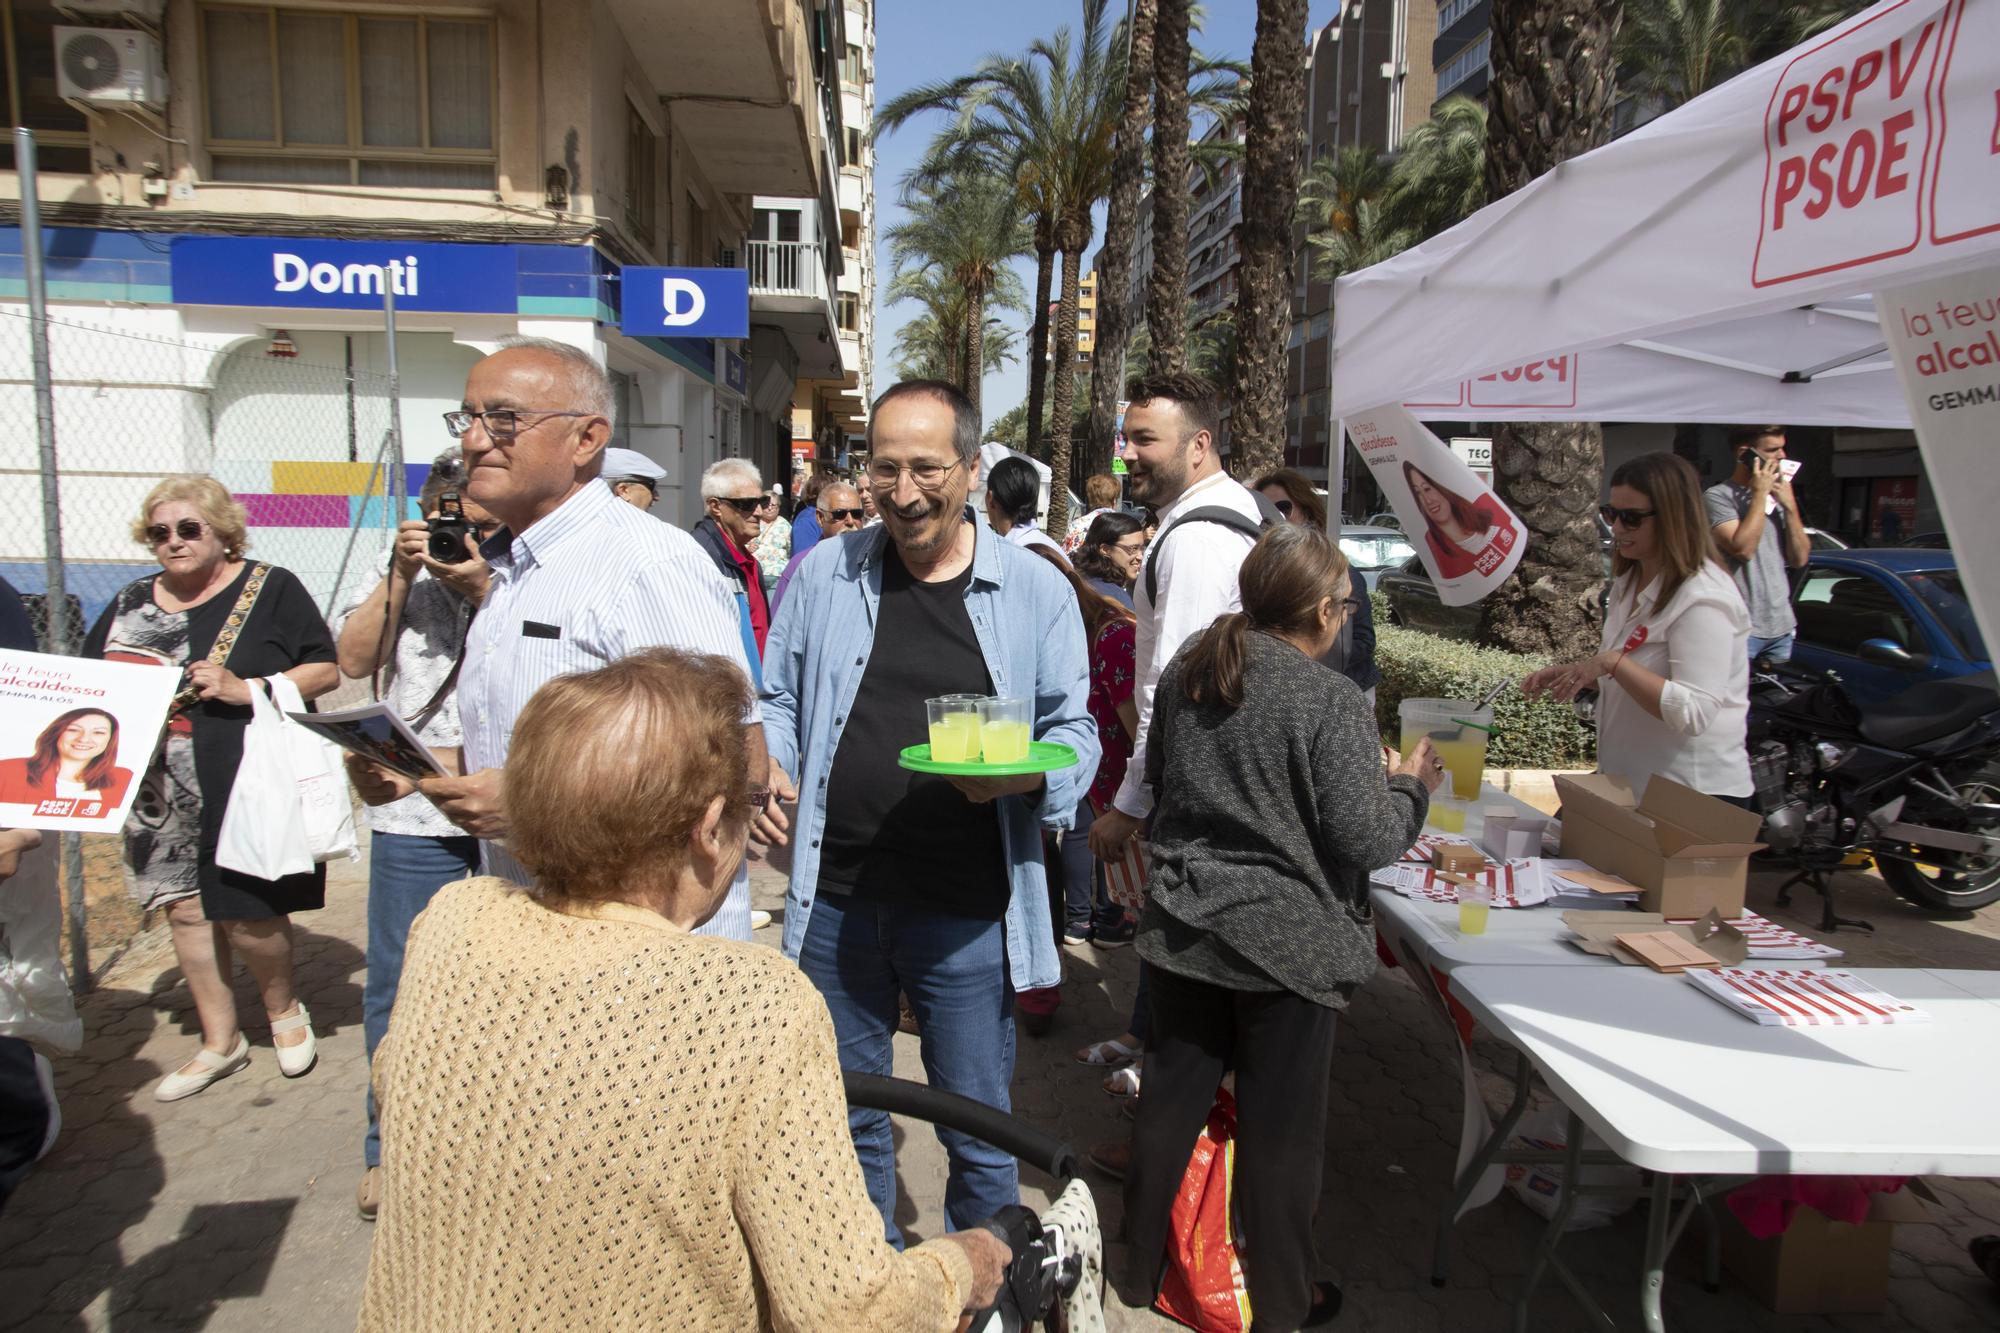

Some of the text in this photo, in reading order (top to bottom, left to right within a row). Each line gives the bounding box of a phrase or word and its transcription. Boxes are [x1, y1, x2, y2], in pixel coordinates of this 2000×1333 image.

[1778, 21, 1936, 147] PSPV
[1773, 110, 1914, 231] PSOE
[273, 253, 418, 295] Domti
[663, 278, 705, 326] D
[1902, 307, 1933, 338] la
[1360, 434, 1397, 451] alcaldessa
[1468, 449, 1491, 459] TEC
[1473, 548, 1495, 568] PSPV
[1480, 553, 1502, 573] PSOE
[2, 662, 72, 681] la teua
[0, 676, 106, 698] alcaldessa
[37, 807, 69, 815] PSOE
[41, 800, 72, 808] PSPV
